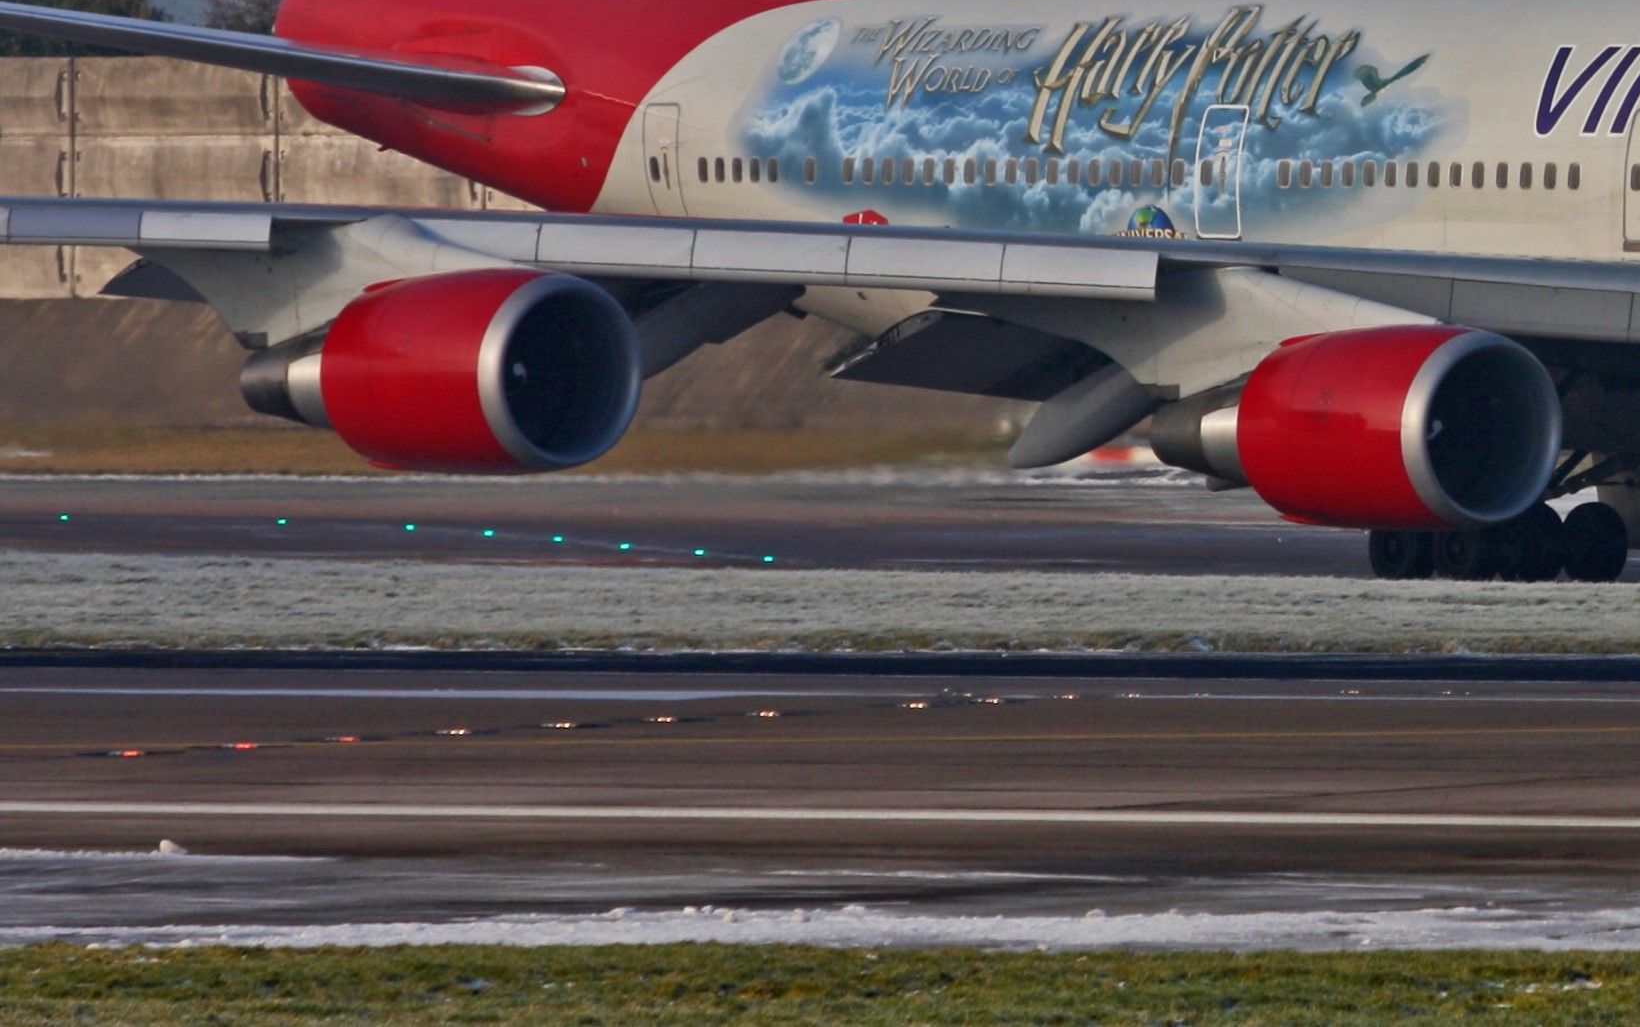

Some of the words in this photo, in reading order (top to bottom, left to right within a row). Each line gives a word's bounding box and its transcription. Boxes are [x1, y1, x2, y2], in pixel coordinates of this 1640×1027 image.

[875, 16, 1042, 67] WIZARDING
[886, 53, 992, 109] WORLD
[1024, 13, 1197, 155] Harry
[1167, 4, 1362, 202] Potter
